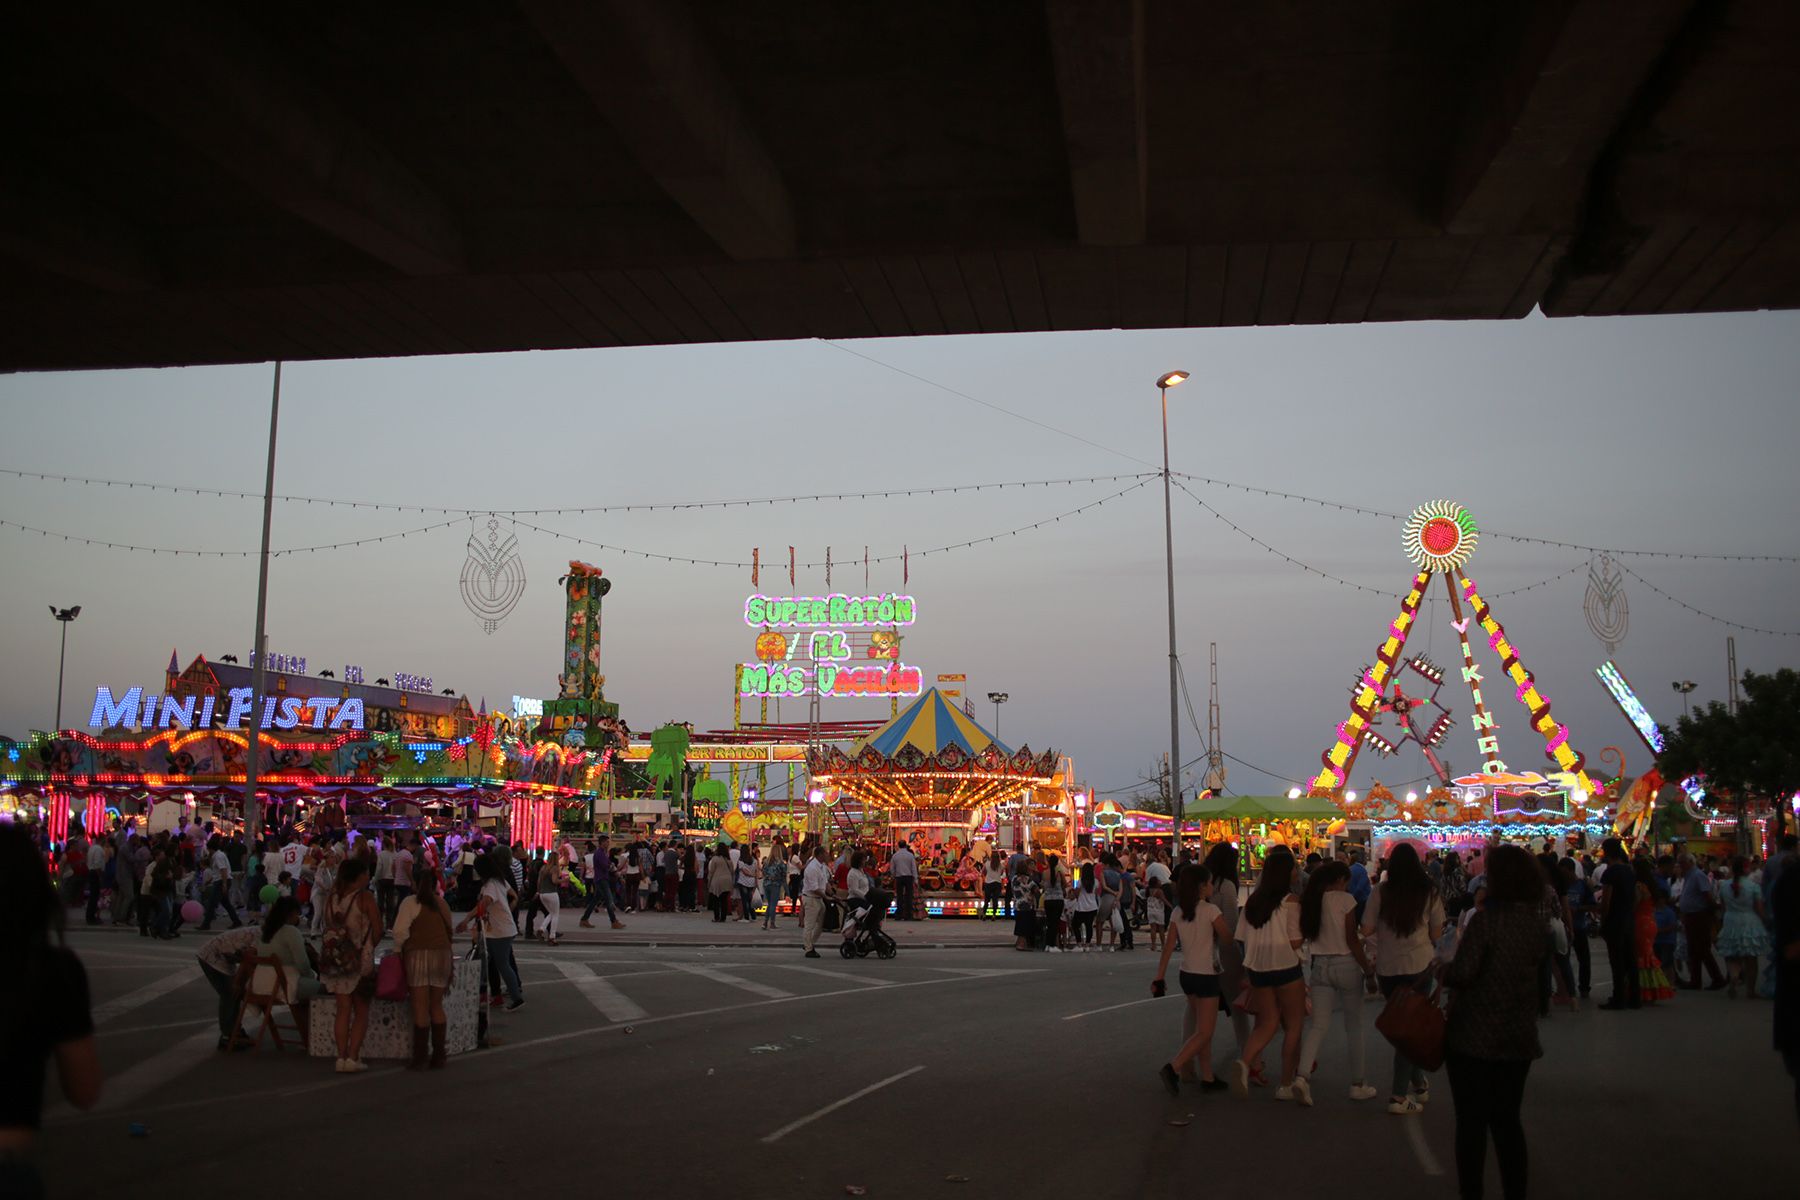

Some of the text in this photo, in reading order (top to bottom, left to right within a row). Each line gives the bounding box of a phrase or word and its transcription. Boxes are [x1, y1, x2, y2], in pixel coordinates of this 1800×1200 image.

[814, 635, 846, 657] EL
[741, 664, 919, 693] MÁS VACILÓN
[88, 686, 365, 730] MINI PISTA
[1450, 617, 1508, 777] VIKINGO
[284, 851, 296, 864] 13
